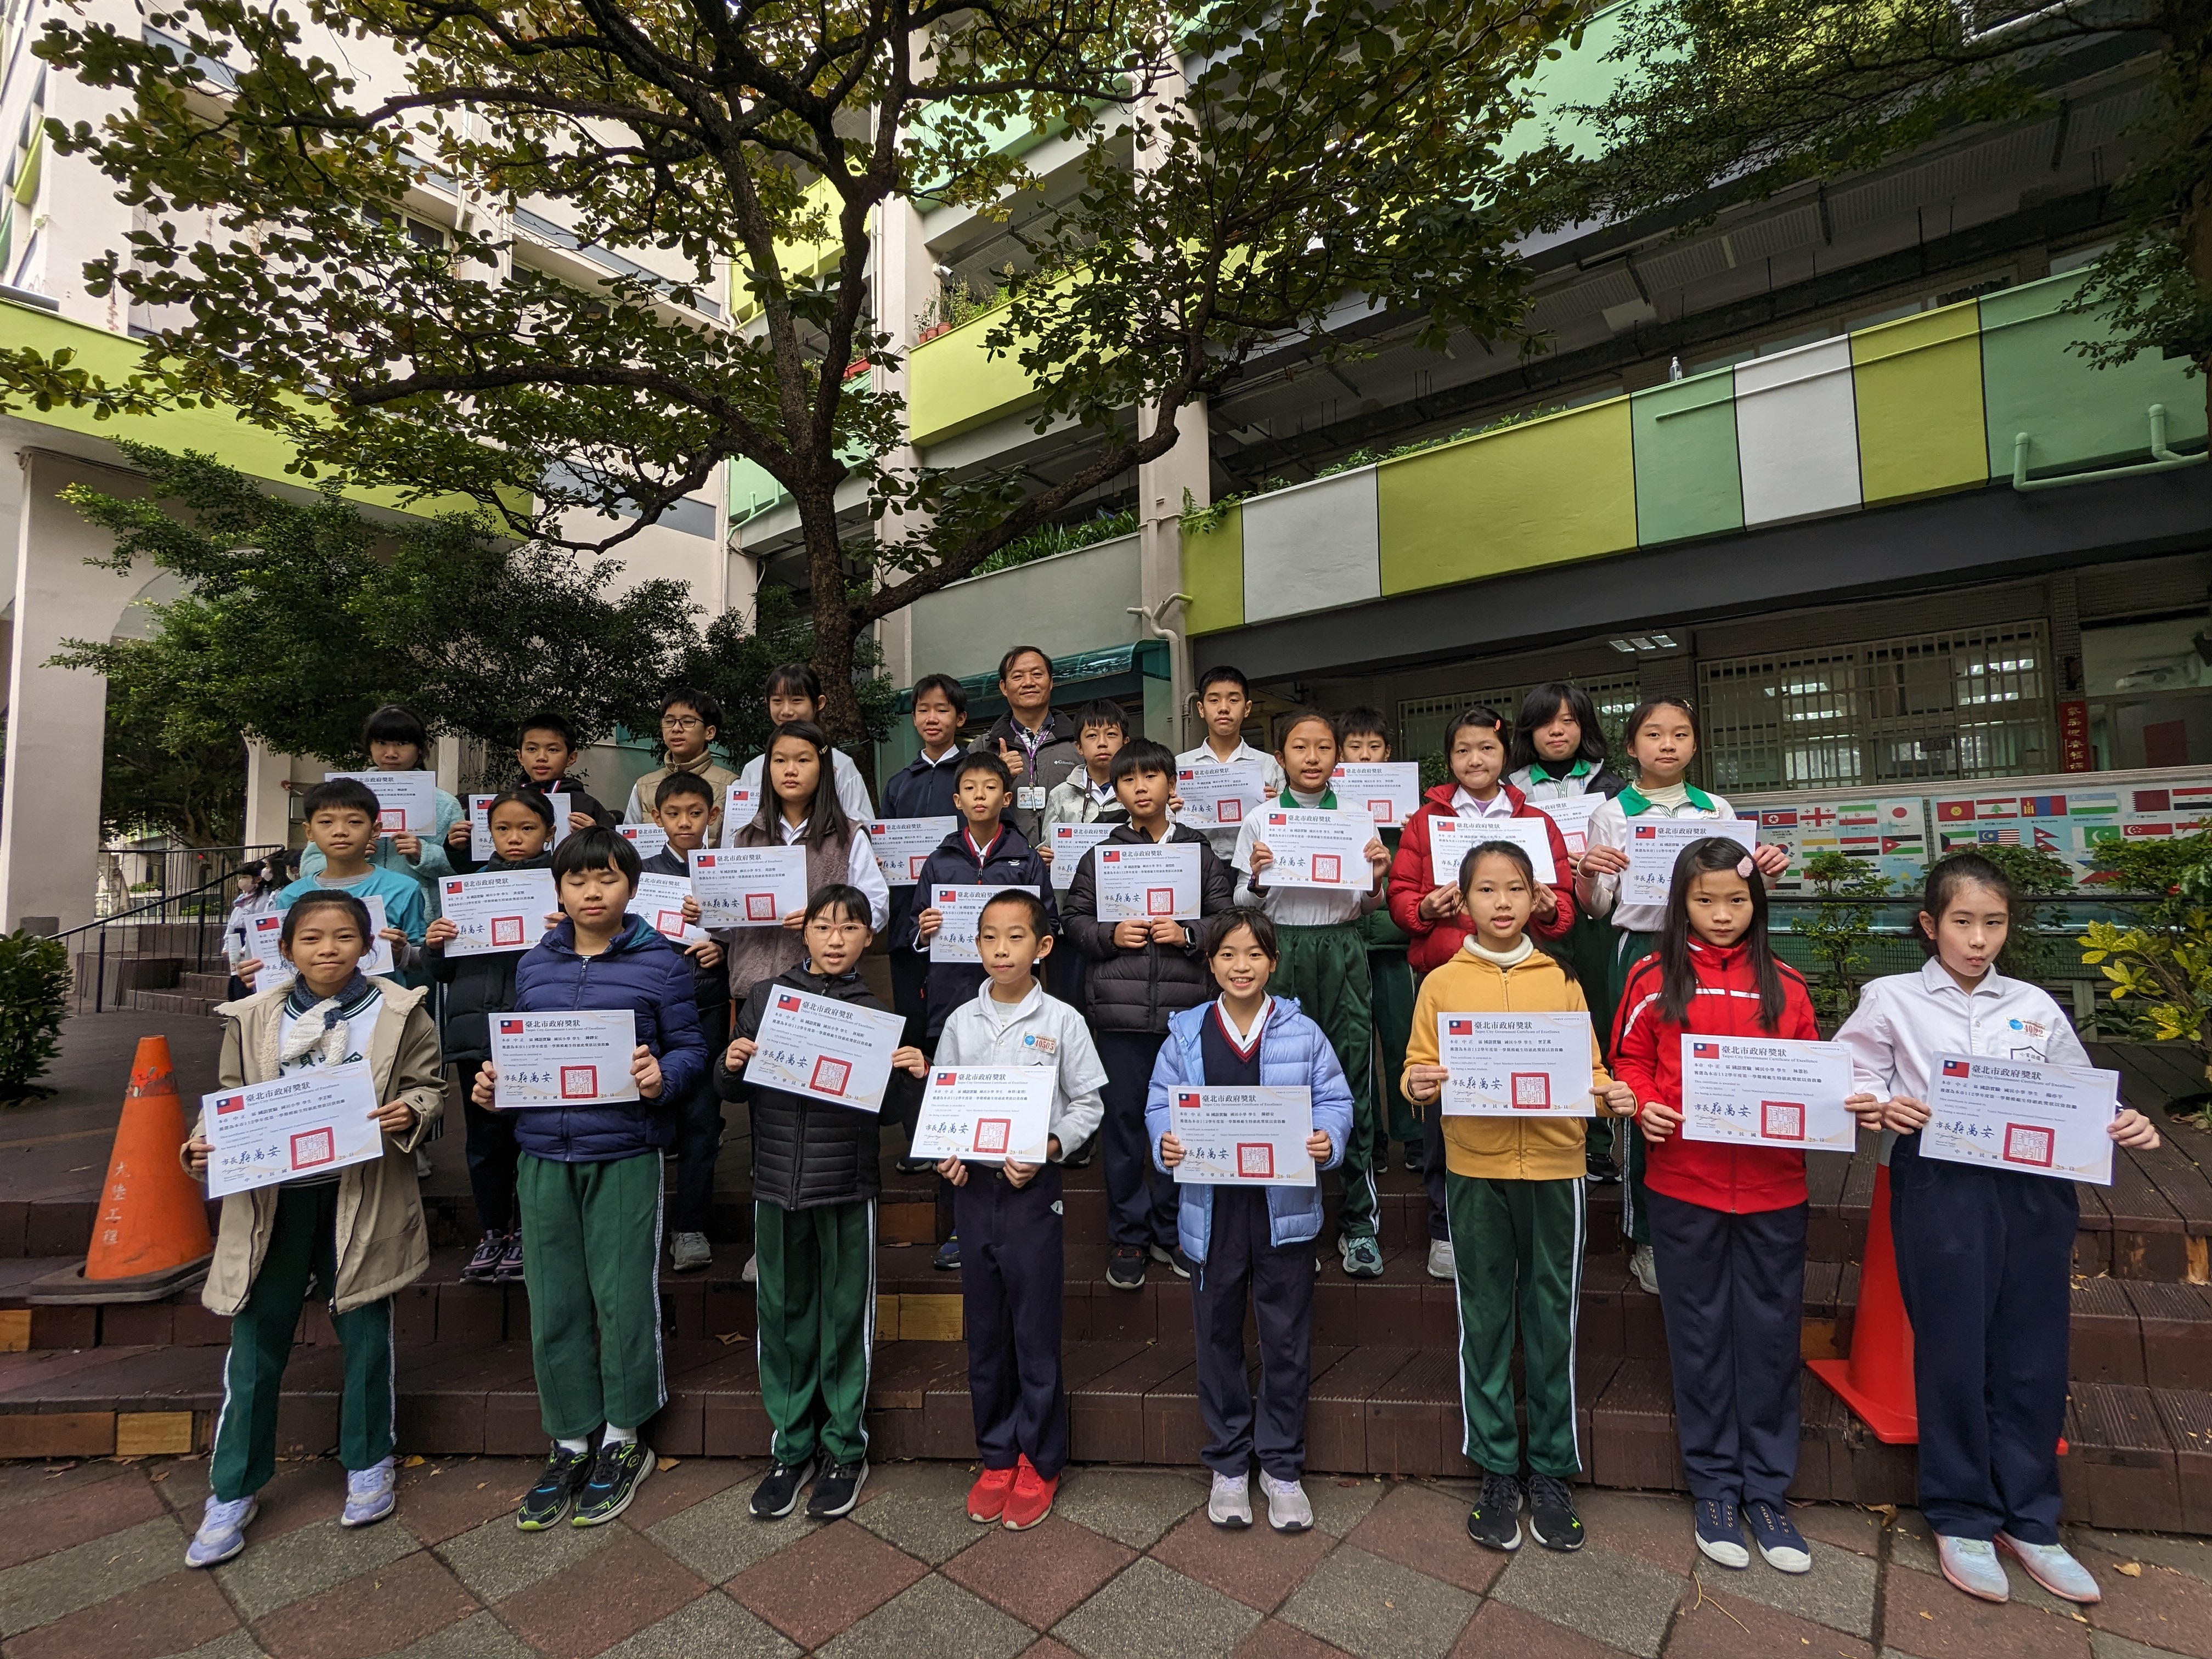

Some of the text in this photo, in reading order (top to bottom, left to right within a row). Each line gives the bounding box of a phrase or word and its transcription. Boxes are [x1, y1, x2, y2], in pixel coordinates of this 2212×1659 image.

[716, 854, 761, 862] 臺北市政府獎狀
[463, 878, 509, 888] 臺北市政府獎狀
[800, 1001, 855, 1020] 臺北市政府獎狀
[525, 1019, 581, 1029] 臺北市政府獎狀
[1474, 1021, 1533, 1030] 臺北市政府獎狀
[1035, 1039, 1054, 1051] 40505
[1722, 1046, 1787, 1058] 臺北市政府獎狀
[1971, 1065, 2044, 1081] 臺北市政府獎狀
[246, 1081, 311, 1104] 臺北市政府獎狀
[1202, 1094, 1256, 1103] 臺北市政府獎狀
